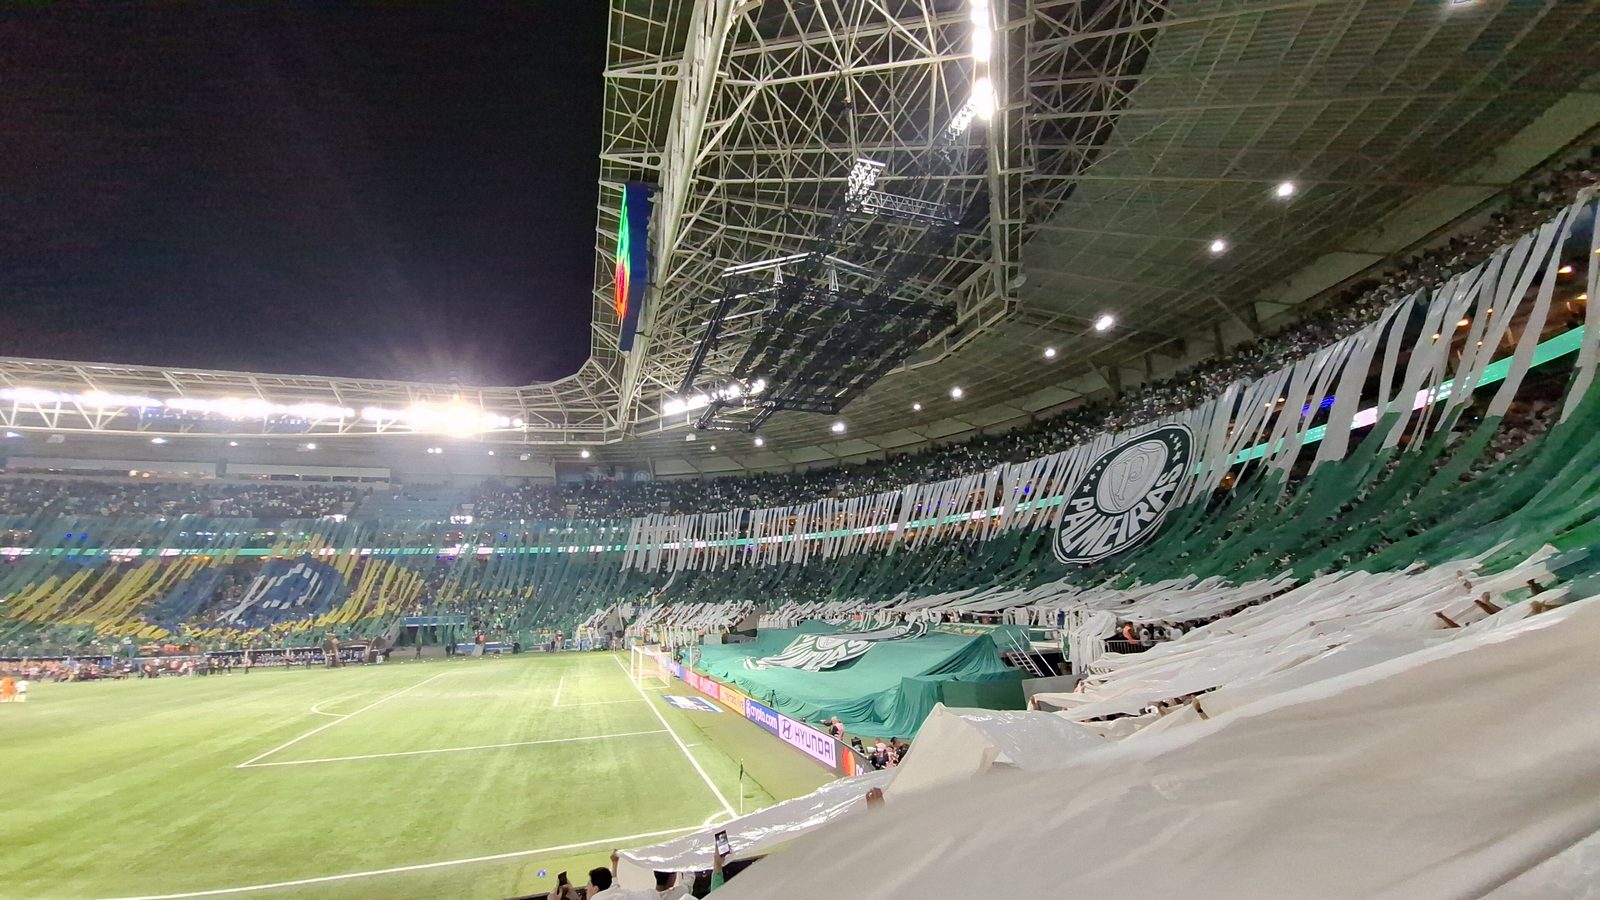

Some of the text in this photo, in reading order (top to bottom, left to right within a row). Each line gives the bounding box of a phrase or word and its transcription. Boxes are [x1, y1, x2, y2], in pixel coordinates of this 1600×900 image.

[1061, 462, 1185, 557] PALMEIRAS
[751, 705, 778, 730] crypto.com
[794, 727, 834, 761] HYUNDAI
